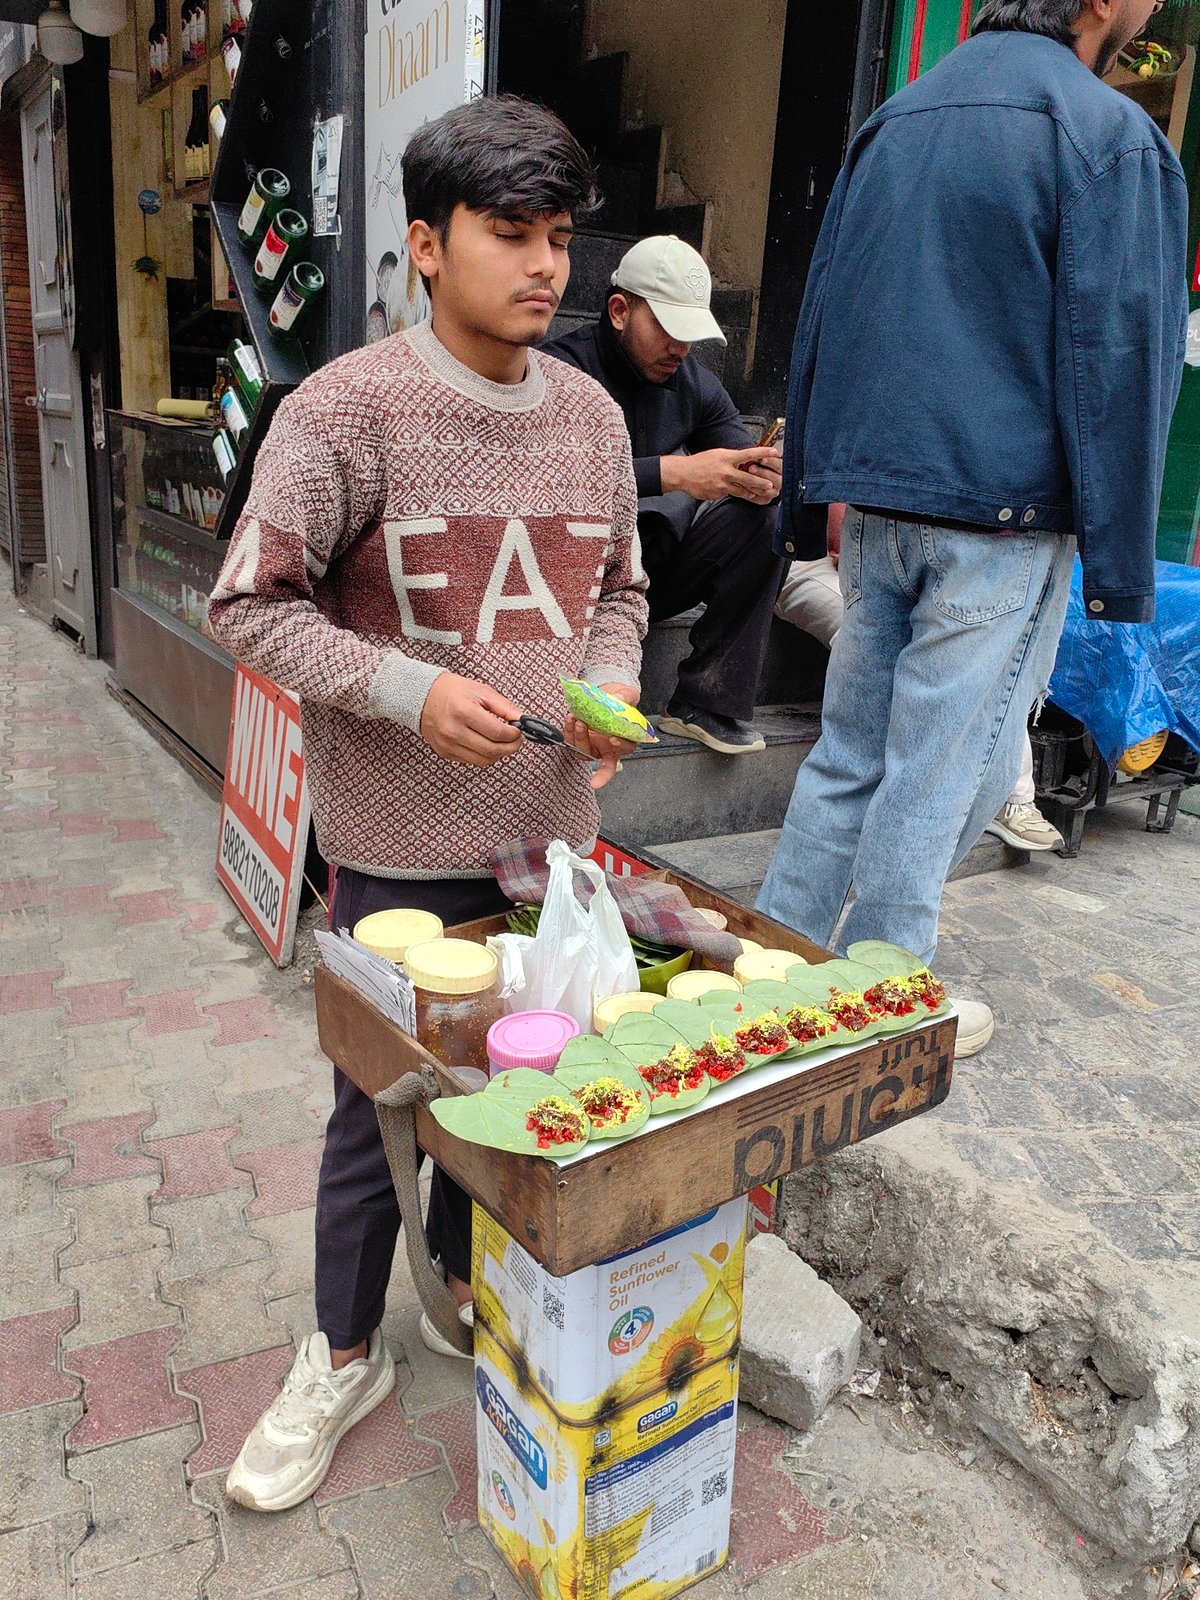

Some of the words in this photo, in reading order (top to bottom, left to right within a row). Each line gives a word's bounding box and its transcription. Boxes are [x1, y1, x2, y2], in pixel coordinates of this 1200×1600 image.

[378, 0, 449, 109] Dhaam
[230, 670, 302, 854] WINE
[222, 819, 280, 928] 9882170208
[609, 1250, 666, 1284] Refined
[609, 1260, 681, 1298] Sunflower
[608, 1295, 628, 1311] Oil
[624, 1320, 637, 1336] 4
[636, 1425, 661, 1441] Refined
[661, 1411, 689, 1432] Sunflower
